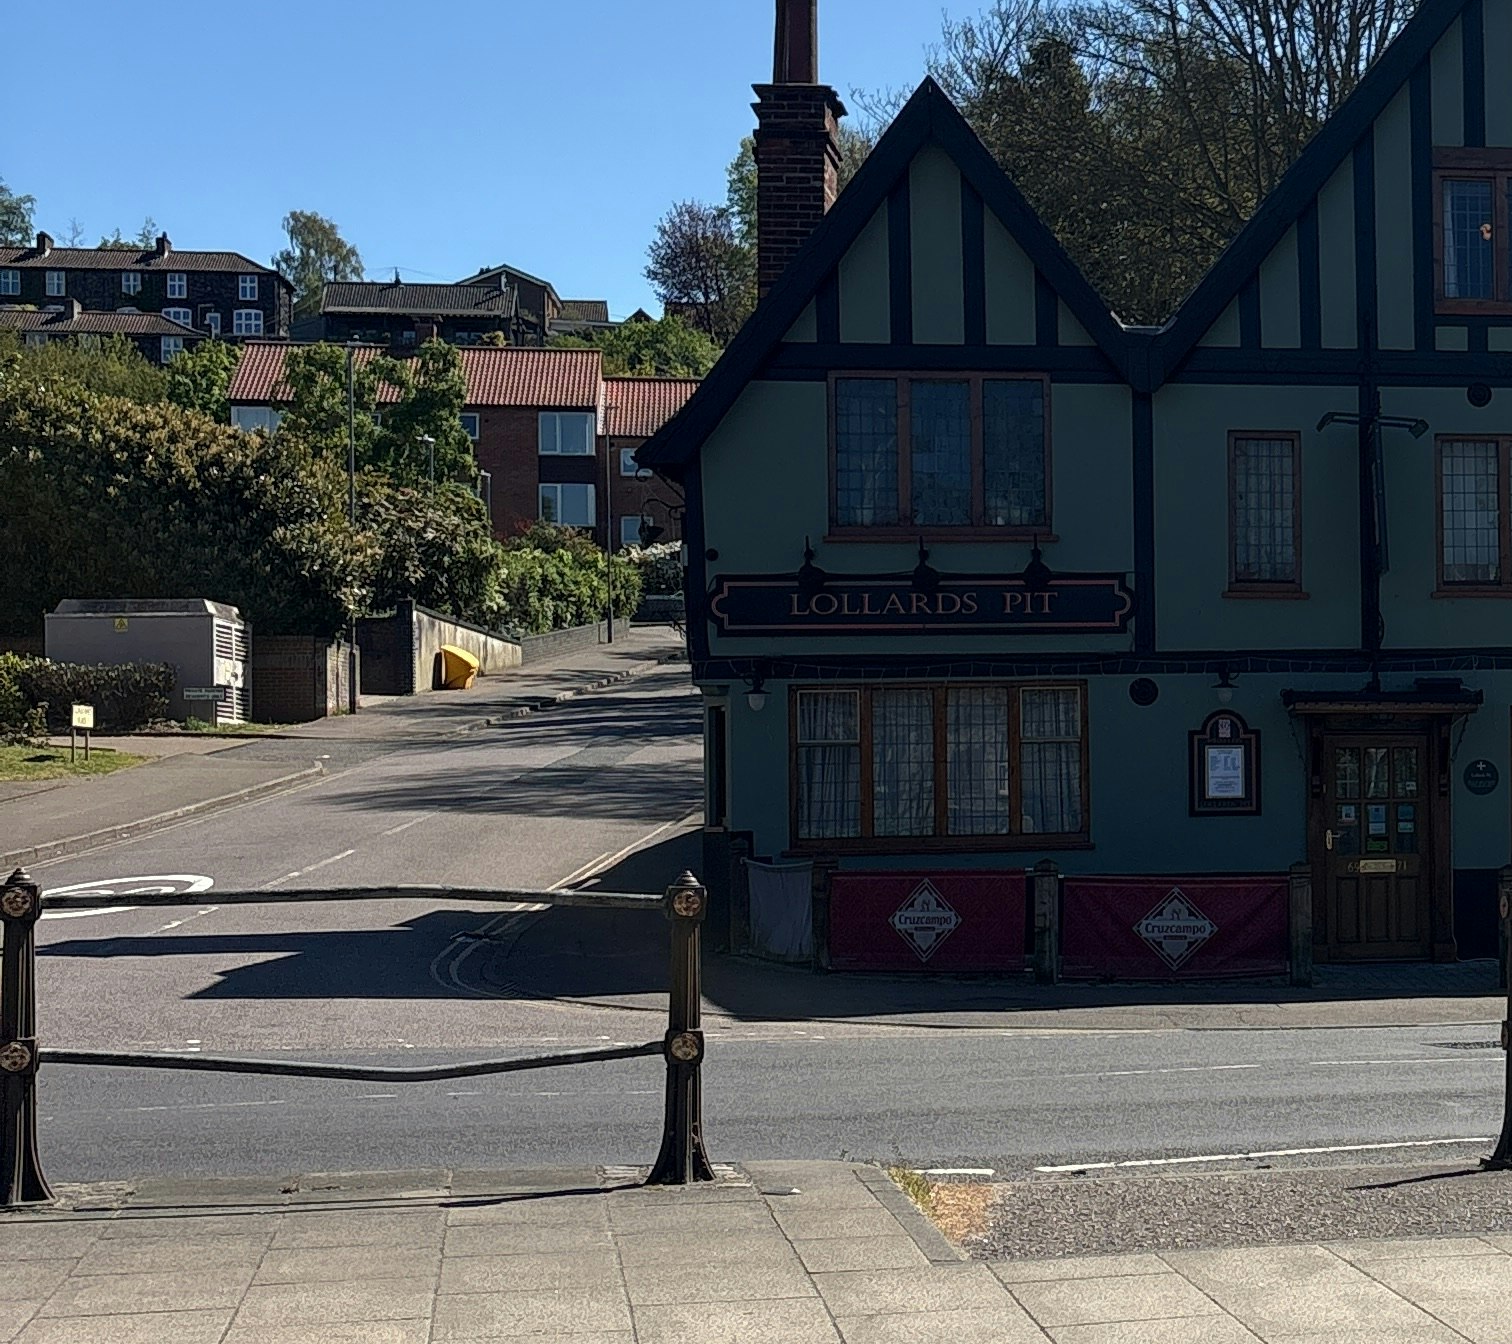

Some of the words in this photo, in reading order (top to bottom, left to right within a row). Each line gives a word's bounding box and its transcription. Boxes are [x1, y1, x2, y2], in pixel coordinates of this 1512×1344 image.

[789, 592, 978, 617] LOLLARDS
[1002, 591, 1059, 614] PIT
[898, 913, 953, 926] Cruzcampo
[1144, 922, 1206, 936] Cruzcampo
